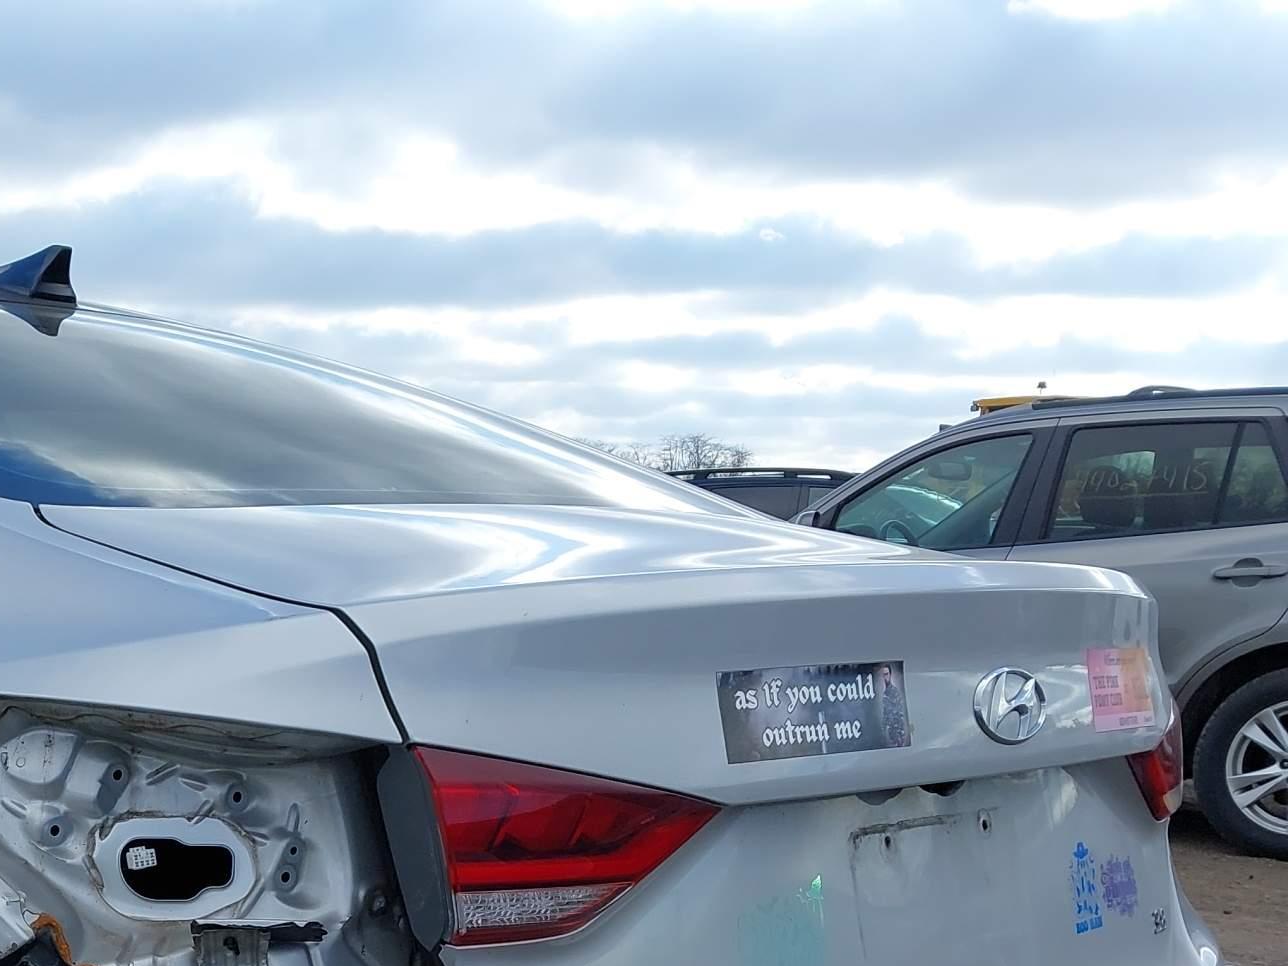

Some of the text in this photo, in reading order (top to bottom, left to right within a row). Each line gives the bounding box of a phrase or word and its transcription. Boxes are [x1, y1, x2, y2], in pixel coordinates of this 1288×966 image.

[734, 674, 875, 713] as if you could
[762, 719, 862, 748] outrun me
